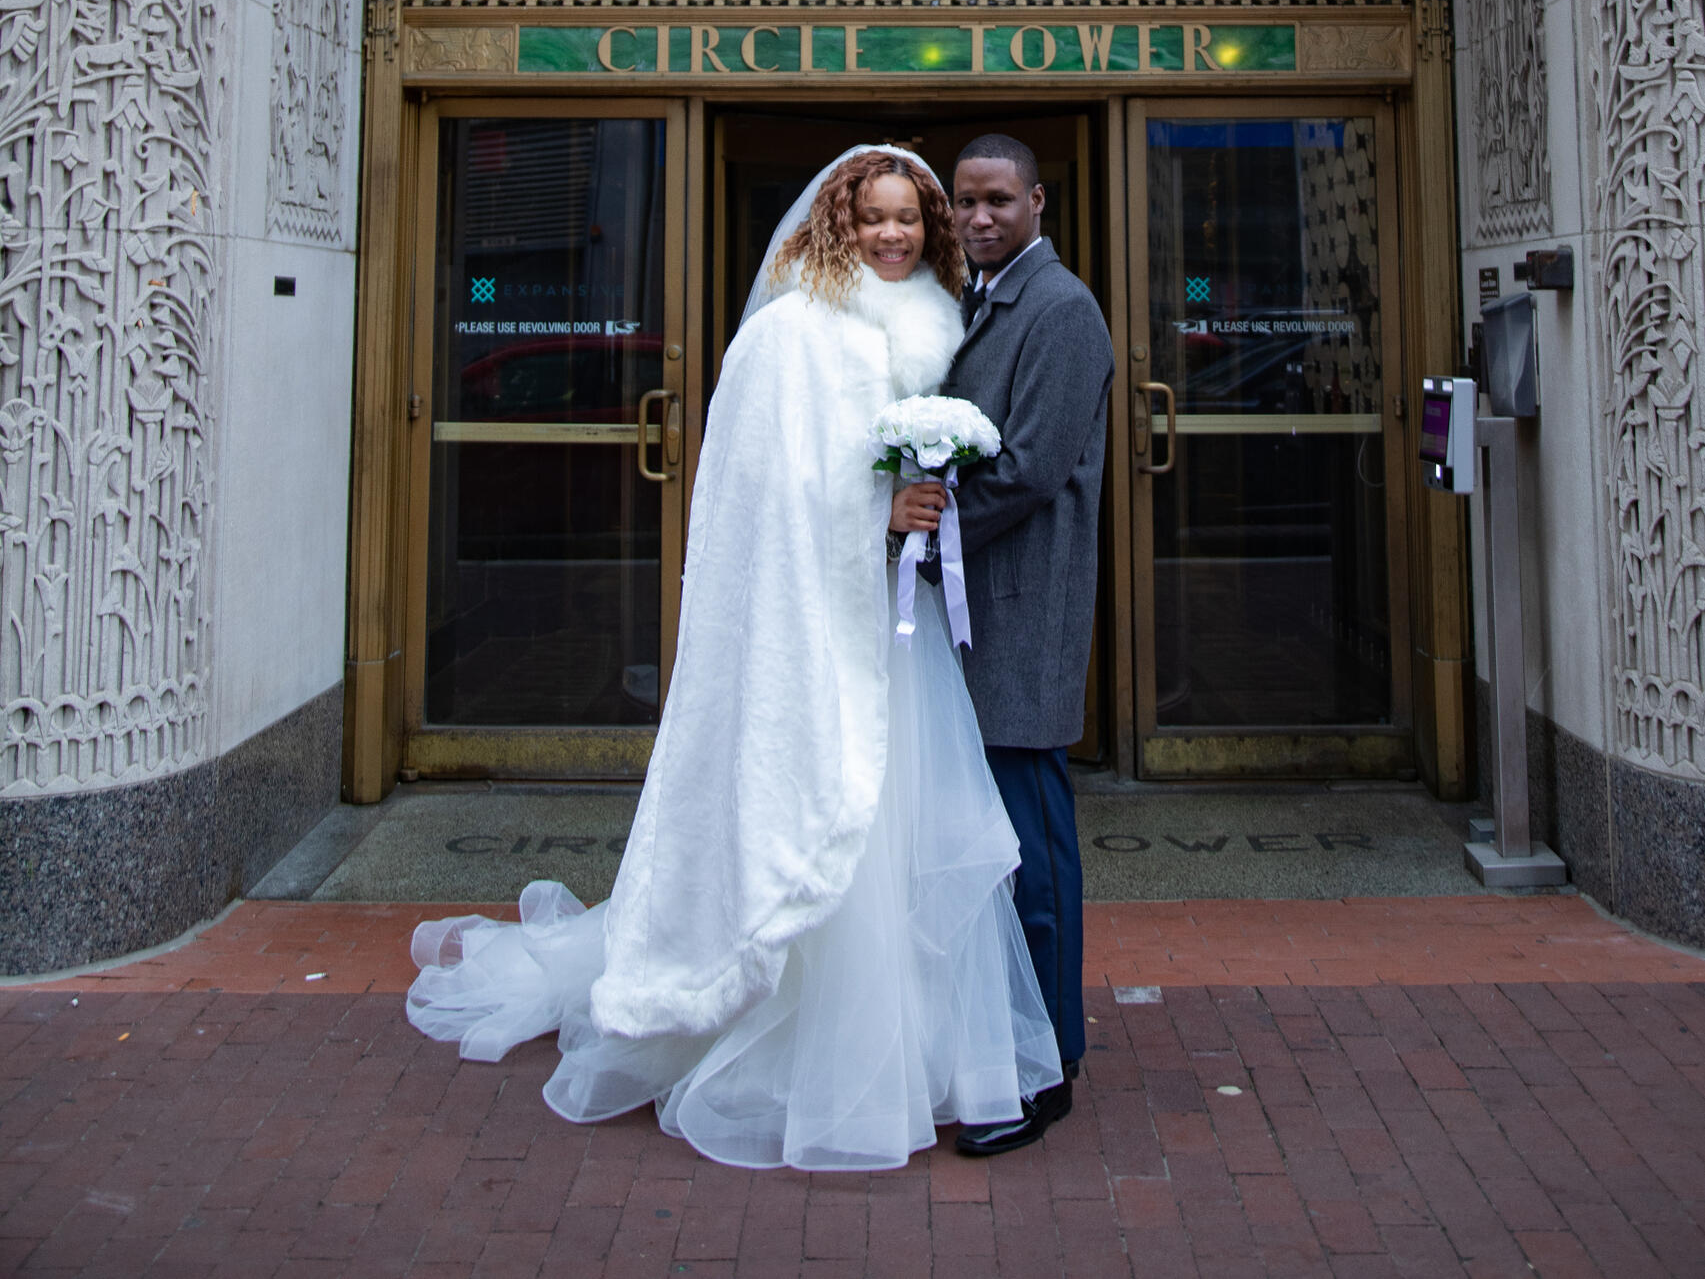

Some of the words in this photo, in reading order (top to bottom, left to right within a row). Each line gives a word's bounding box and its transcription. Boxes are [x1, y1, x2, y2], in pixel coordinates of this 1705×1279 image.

[596, 24, 873, 73] CIRCLE
[959, 23, 1227, 73] TOWER
[458, 321, 495, 334] PLEASE
[497, 321, 516, 334] USE
[519, 321, 571, 334] REVOLVING
[573, 321, 601, 334] DOOR
[1212, 320, 1249, 333] PLEASE
[1251, 320, 1270, 333] USE
[1273, 320, 1326, 333] REVOLVING
[1328, 320, 1355, 333] DOOR
[1092, 833, 1379, 852] OWER
